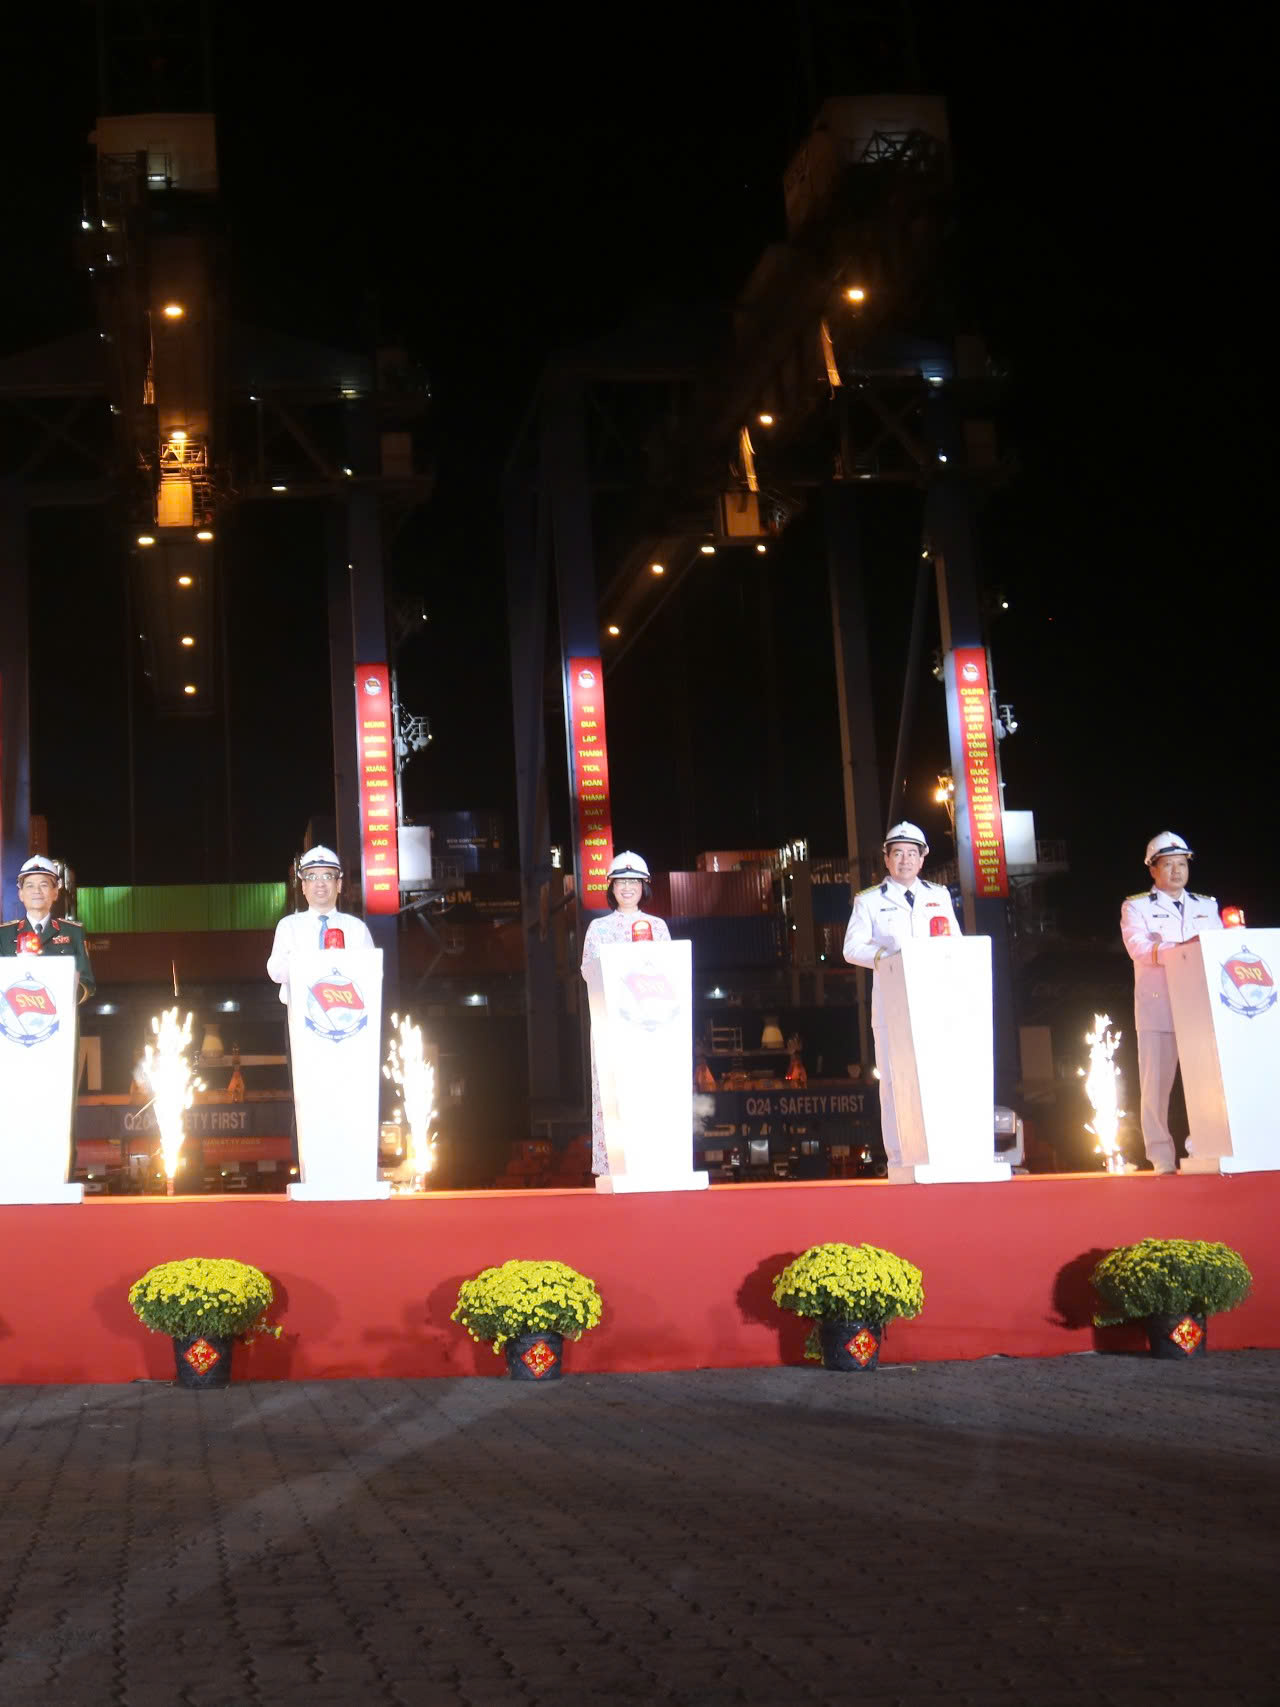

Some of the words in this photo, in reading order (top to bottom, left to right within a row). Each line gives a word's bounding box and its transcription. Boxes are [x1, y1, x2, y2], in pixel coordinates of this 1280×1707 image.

[1234, 966, 1264, 981] SNP
[15, 993, 46, 1009] SNP
[323, 989, 353, 1004] SNP
[779, 1096, 827, 1114] SAFETY
[830, 1095, 865, 1112] FIRST
[211, 1111, 247, 1129] FIRST
